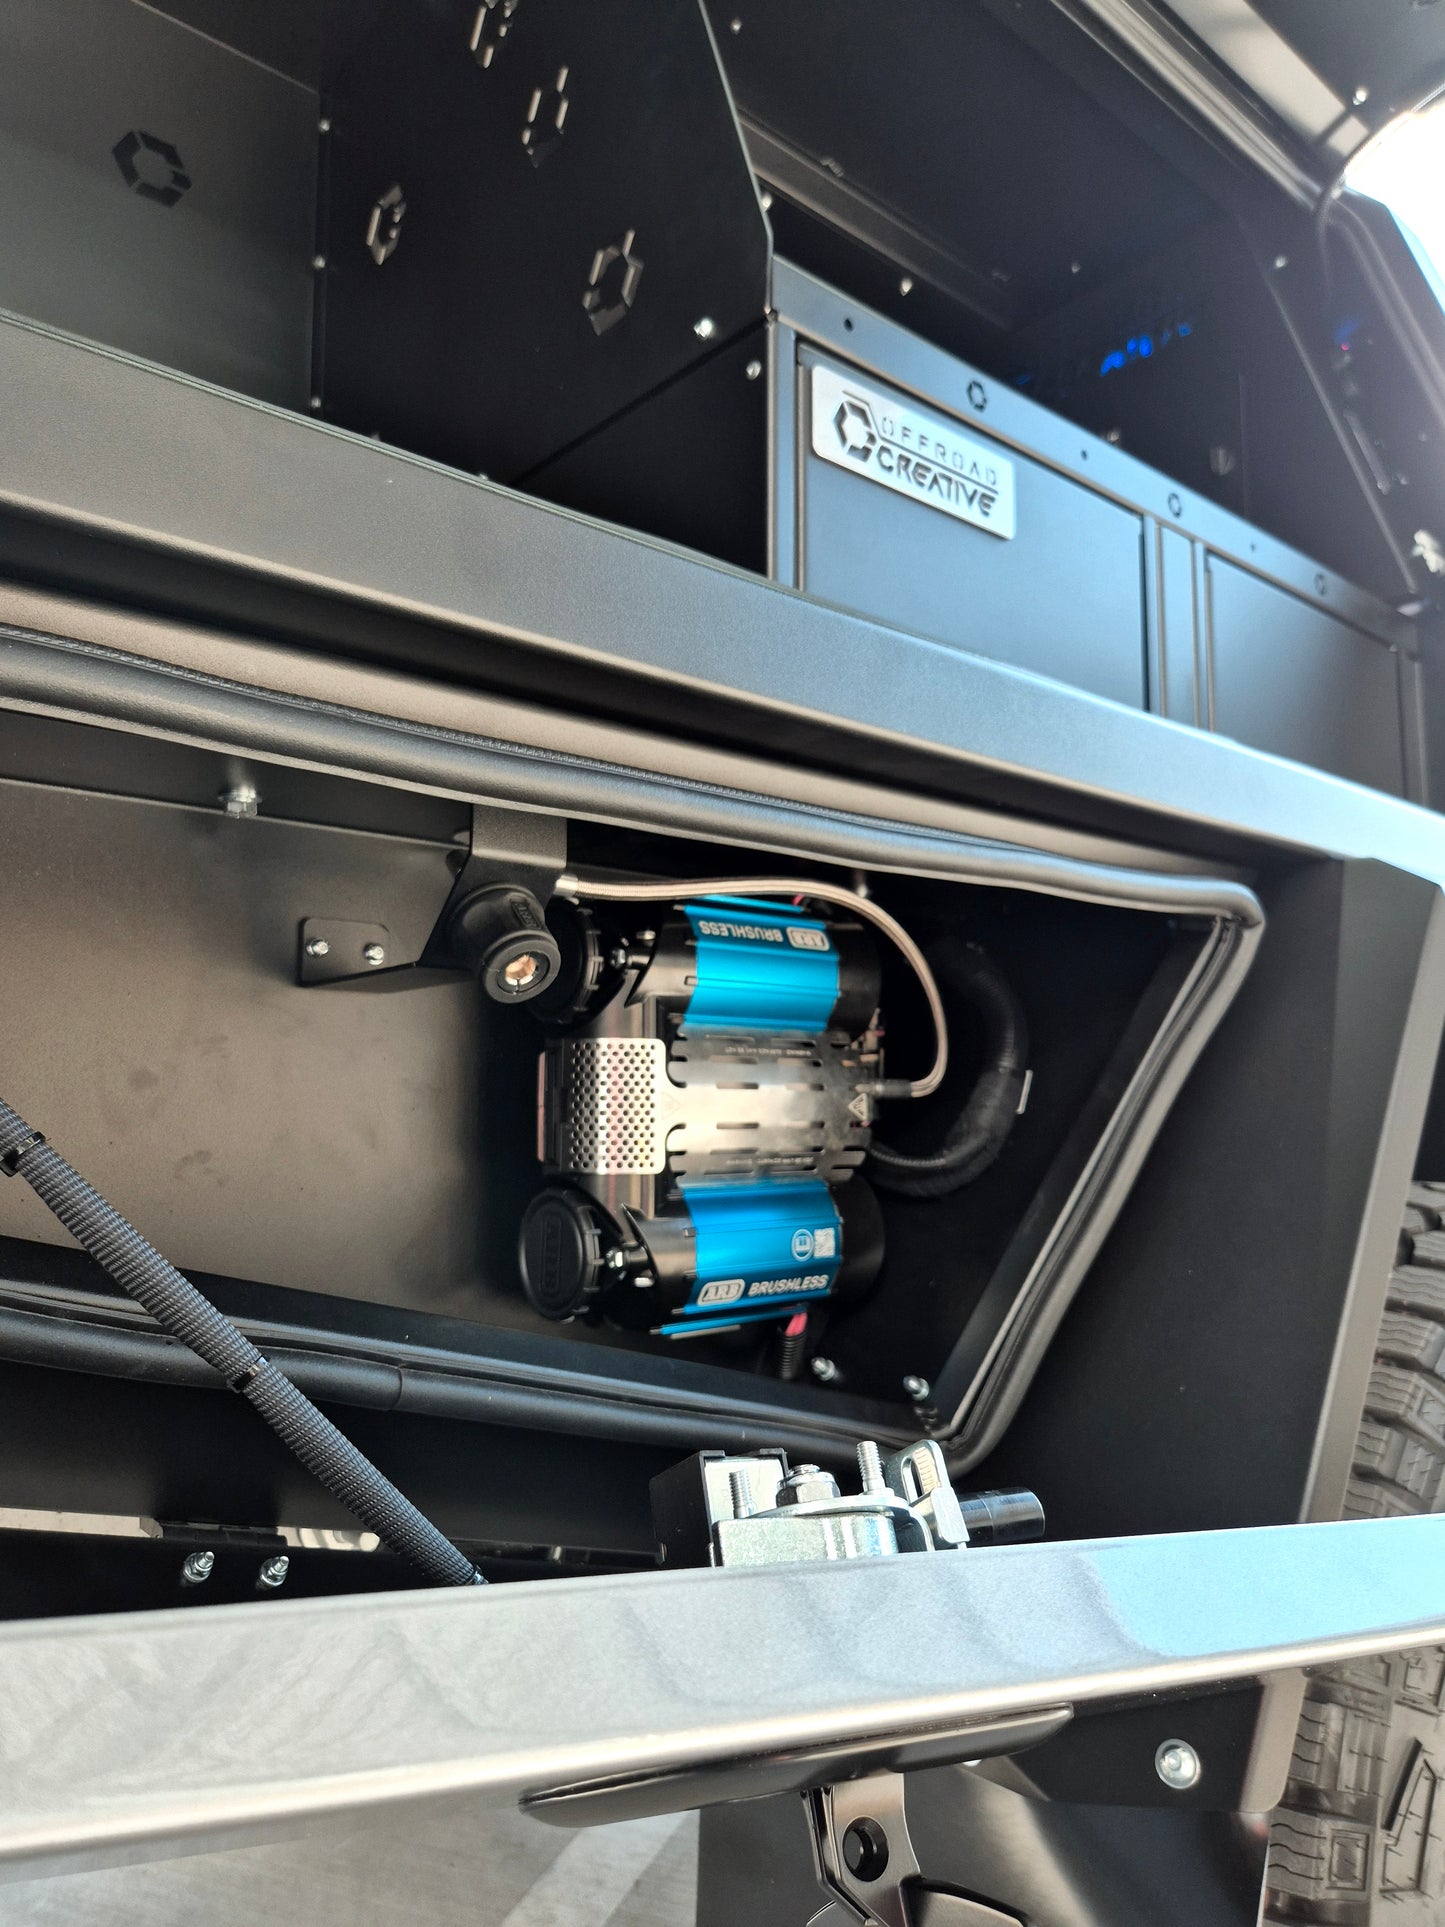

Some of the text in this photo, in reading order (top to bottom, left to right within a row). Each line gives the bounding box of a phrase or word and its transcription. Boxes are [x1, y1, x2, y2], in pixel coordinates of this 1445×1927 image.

[882, 417, 997, 486] OFFROAD
[876, 445, 996, 517] CREATIVE
[698, 920, 784, 943] BRUSHLESS
[700, 1274, 829, 1303] ARB BRUSHLESS
